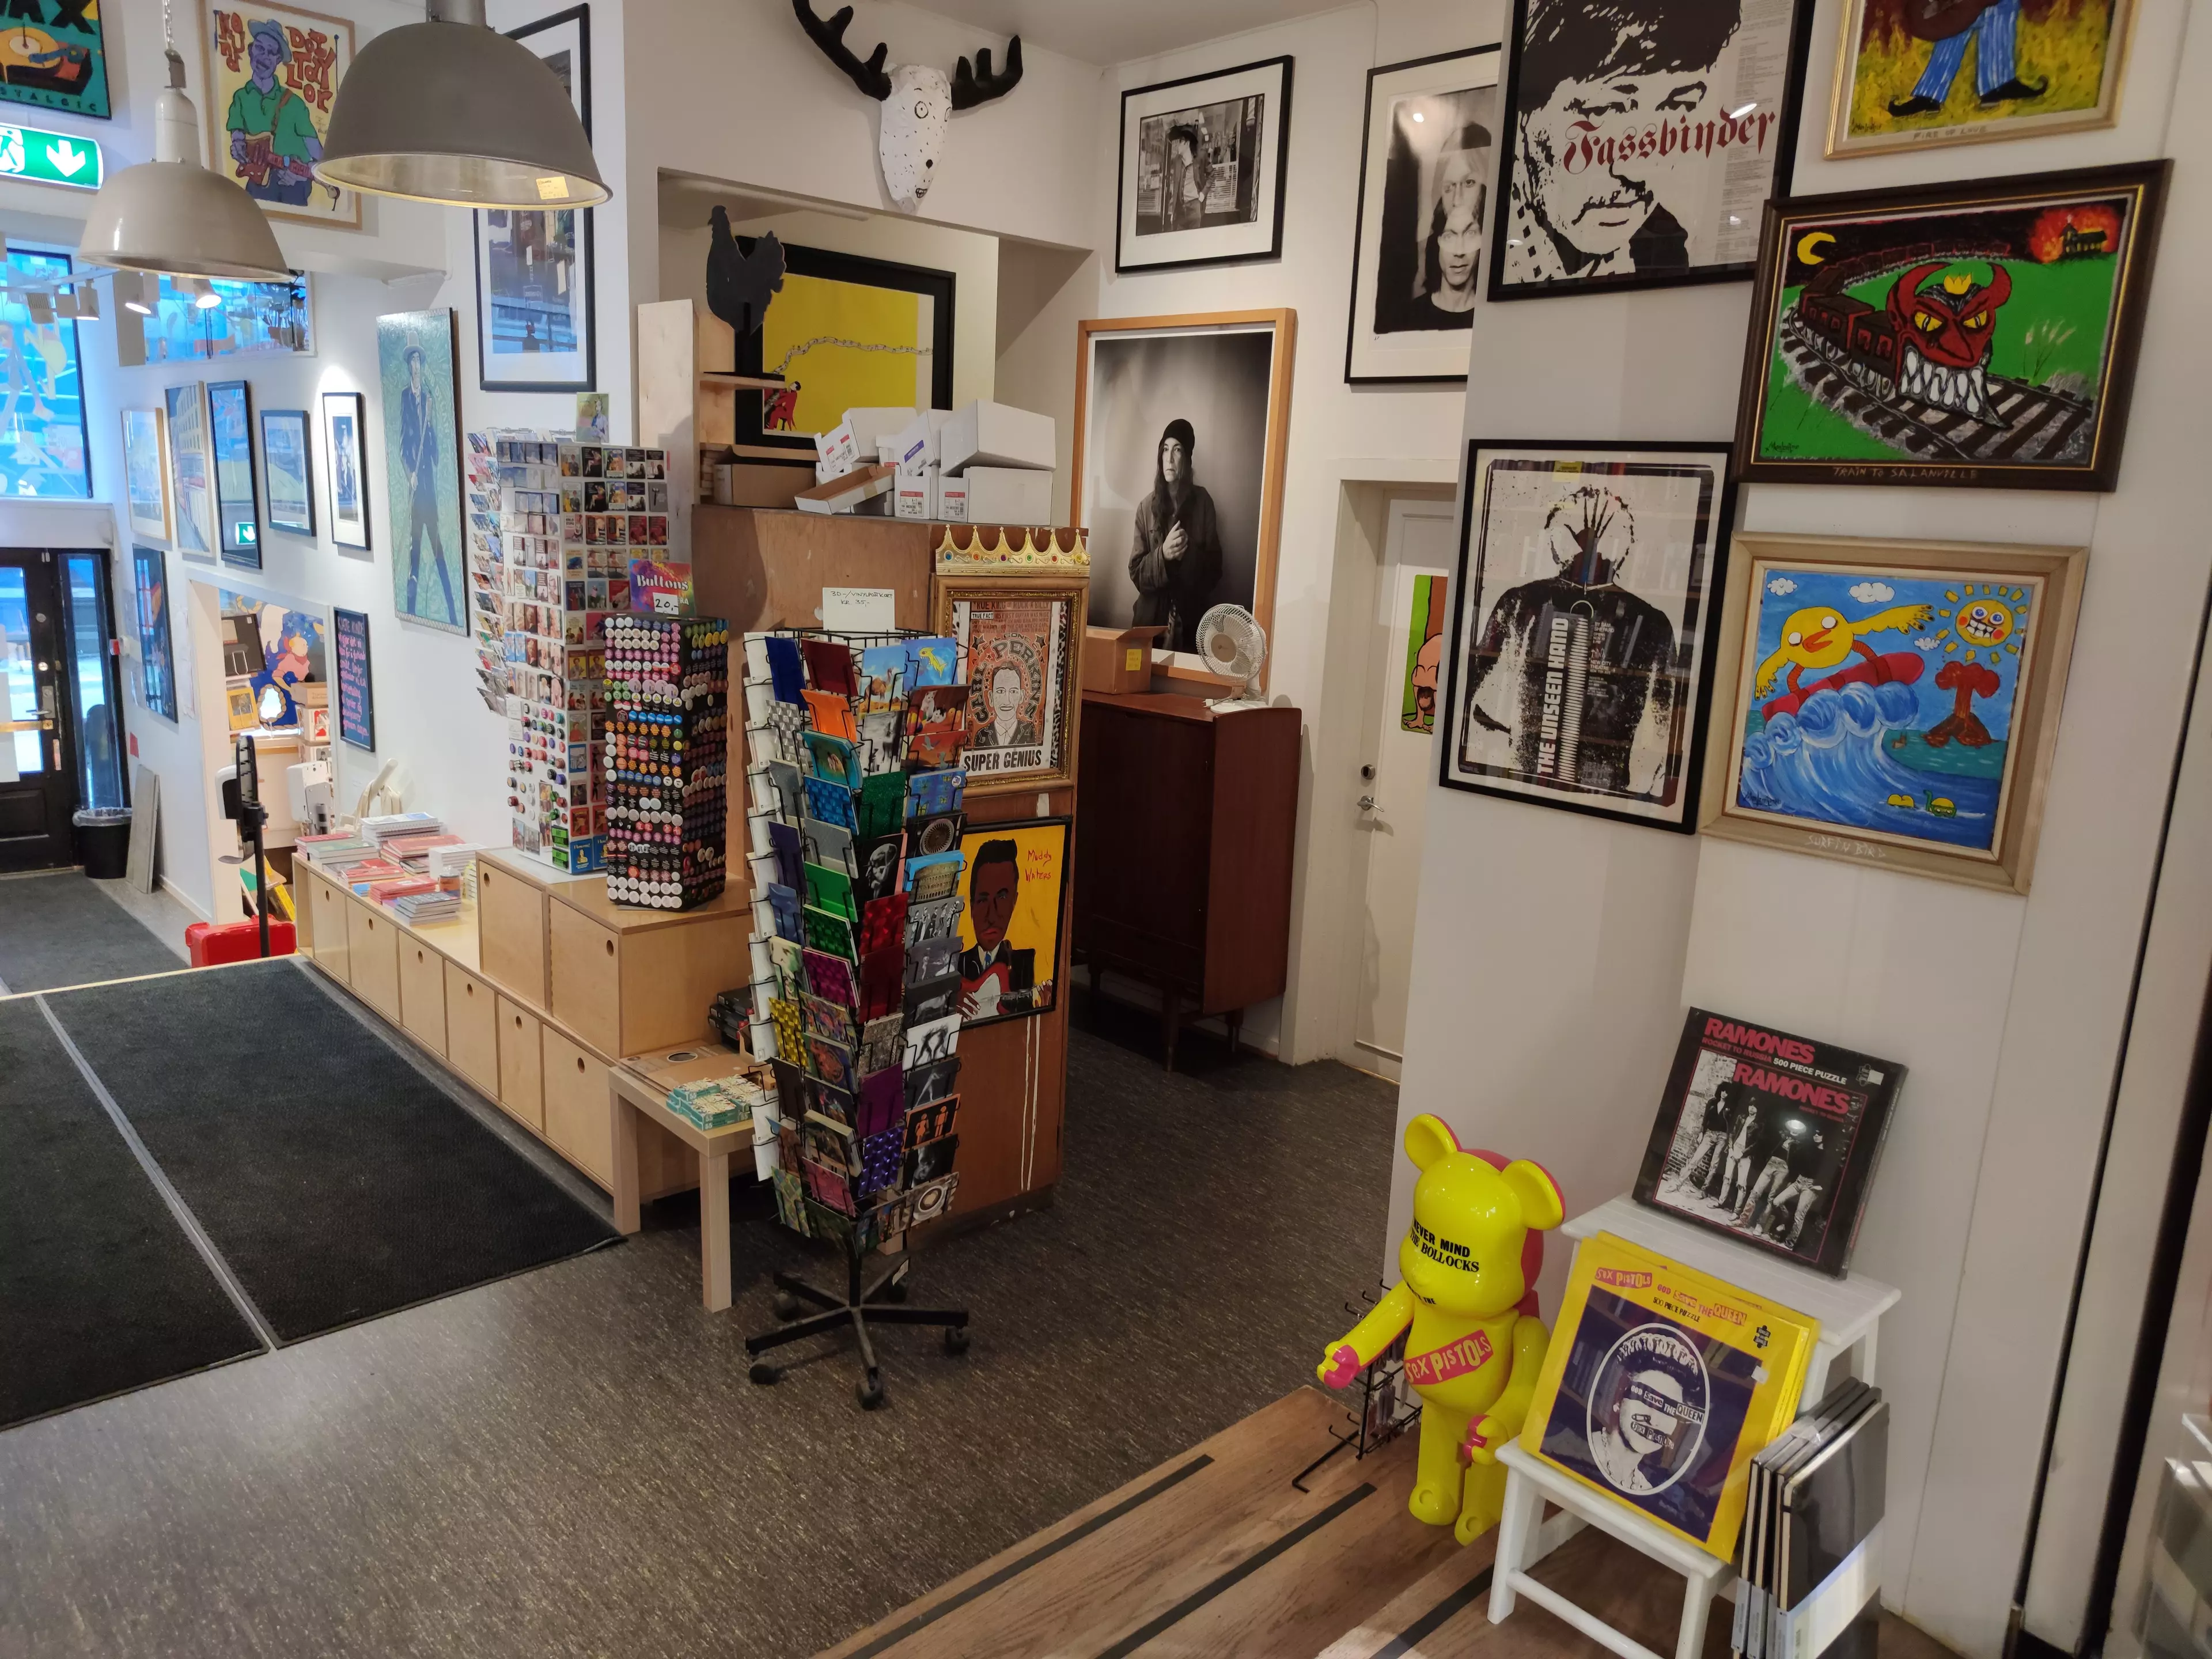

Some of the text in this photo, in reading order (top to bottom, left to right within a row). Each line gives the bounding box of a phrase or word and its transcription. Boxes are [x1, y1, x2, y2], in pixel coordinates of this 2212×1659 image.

[1563, 104, 1775, 175] Fassbinder
[1912, 131, 1938, 140] FIRE
[1834, 467, 1866, 476] TRAIN
[637, 574, 688, 590] Buttons
[656, 599, 679, 611] 20,-
[1548, 618, 1569, 669] HAND
[964, 750, 1041, 772] SUPER GENIUS
[1537, 742, 1556, 774] THE
[1027, 849, 1052, 866] Muddy
[1855, 842, 1886, 858] BIRD
[1705, 1017, 1816, 1064] RAMONES
[1744, 1049, 1772, 1062] RUSSIA
[1773, 1058, 1789, 1068] 500
[1789, 1062, 1814, 1075] PIECE
[1815, 1069, 1847, 1085] PUZZLE
[1733, 1062, 1851, 1114] RAMONES
[1410, 1227, 1479, 1272] THE BOLLOCKS
[1413, 1217, 1470, 1257] NEVER MIND
[1616, 1272, 1651, 1287] PISTOLS
[1653, 1297, 1701, 1323] 500 PIECE PUZZLE
[1657, 1284, 1747, 1325] GOD Save THE QUEEN
[1430, 1336, 1491, 1381] PISTOLS
[1631, 1385, 1703, 1423] GOD Save THE QUEEN
